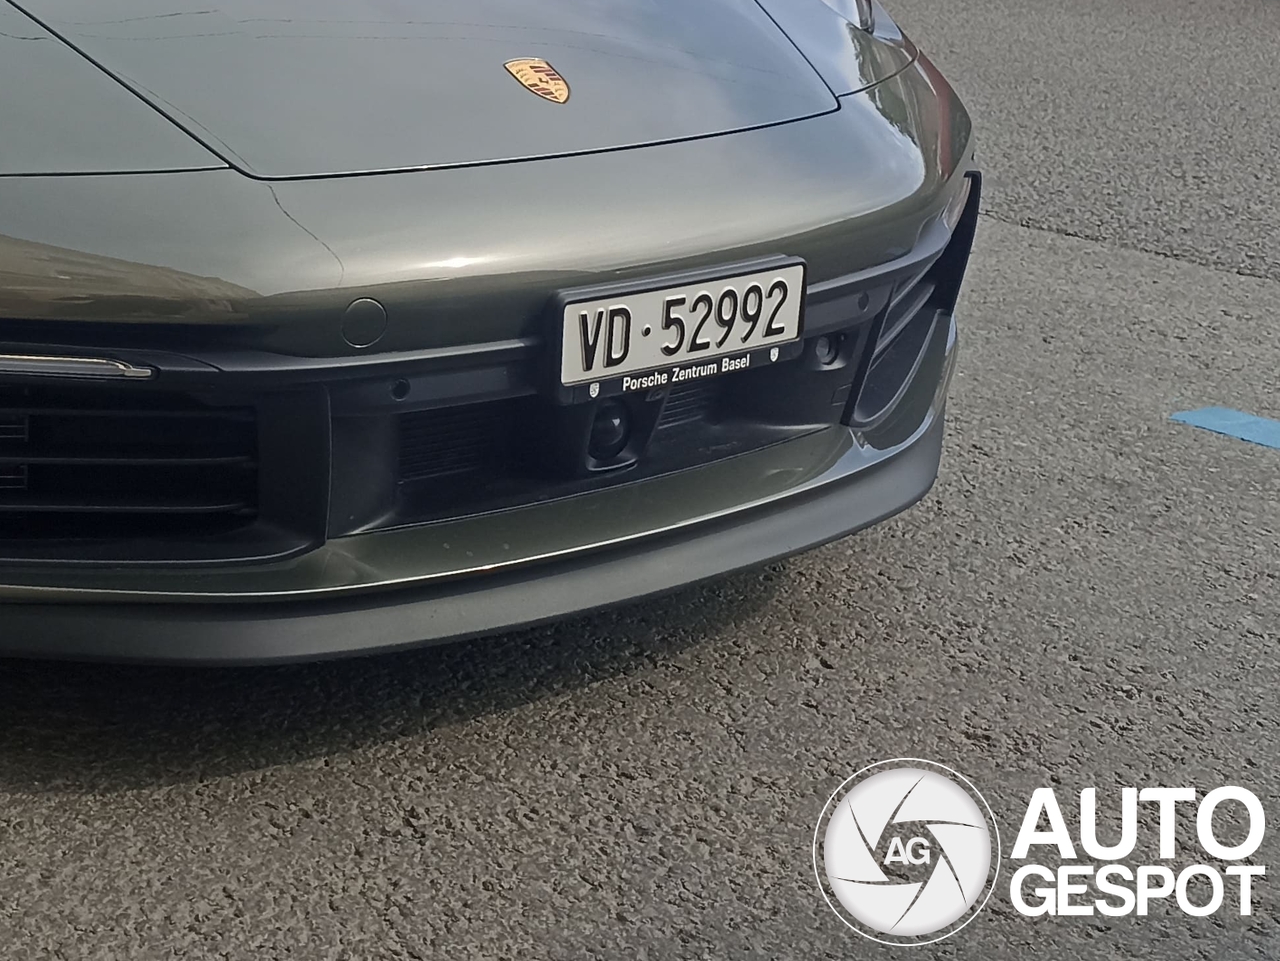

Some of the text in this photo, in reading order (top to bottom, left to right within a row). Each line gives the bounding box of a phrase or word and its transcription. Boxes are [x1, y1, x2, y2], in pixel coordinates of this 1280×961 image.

[622, 353, 750, 391] Porsche Zentrum Basel
